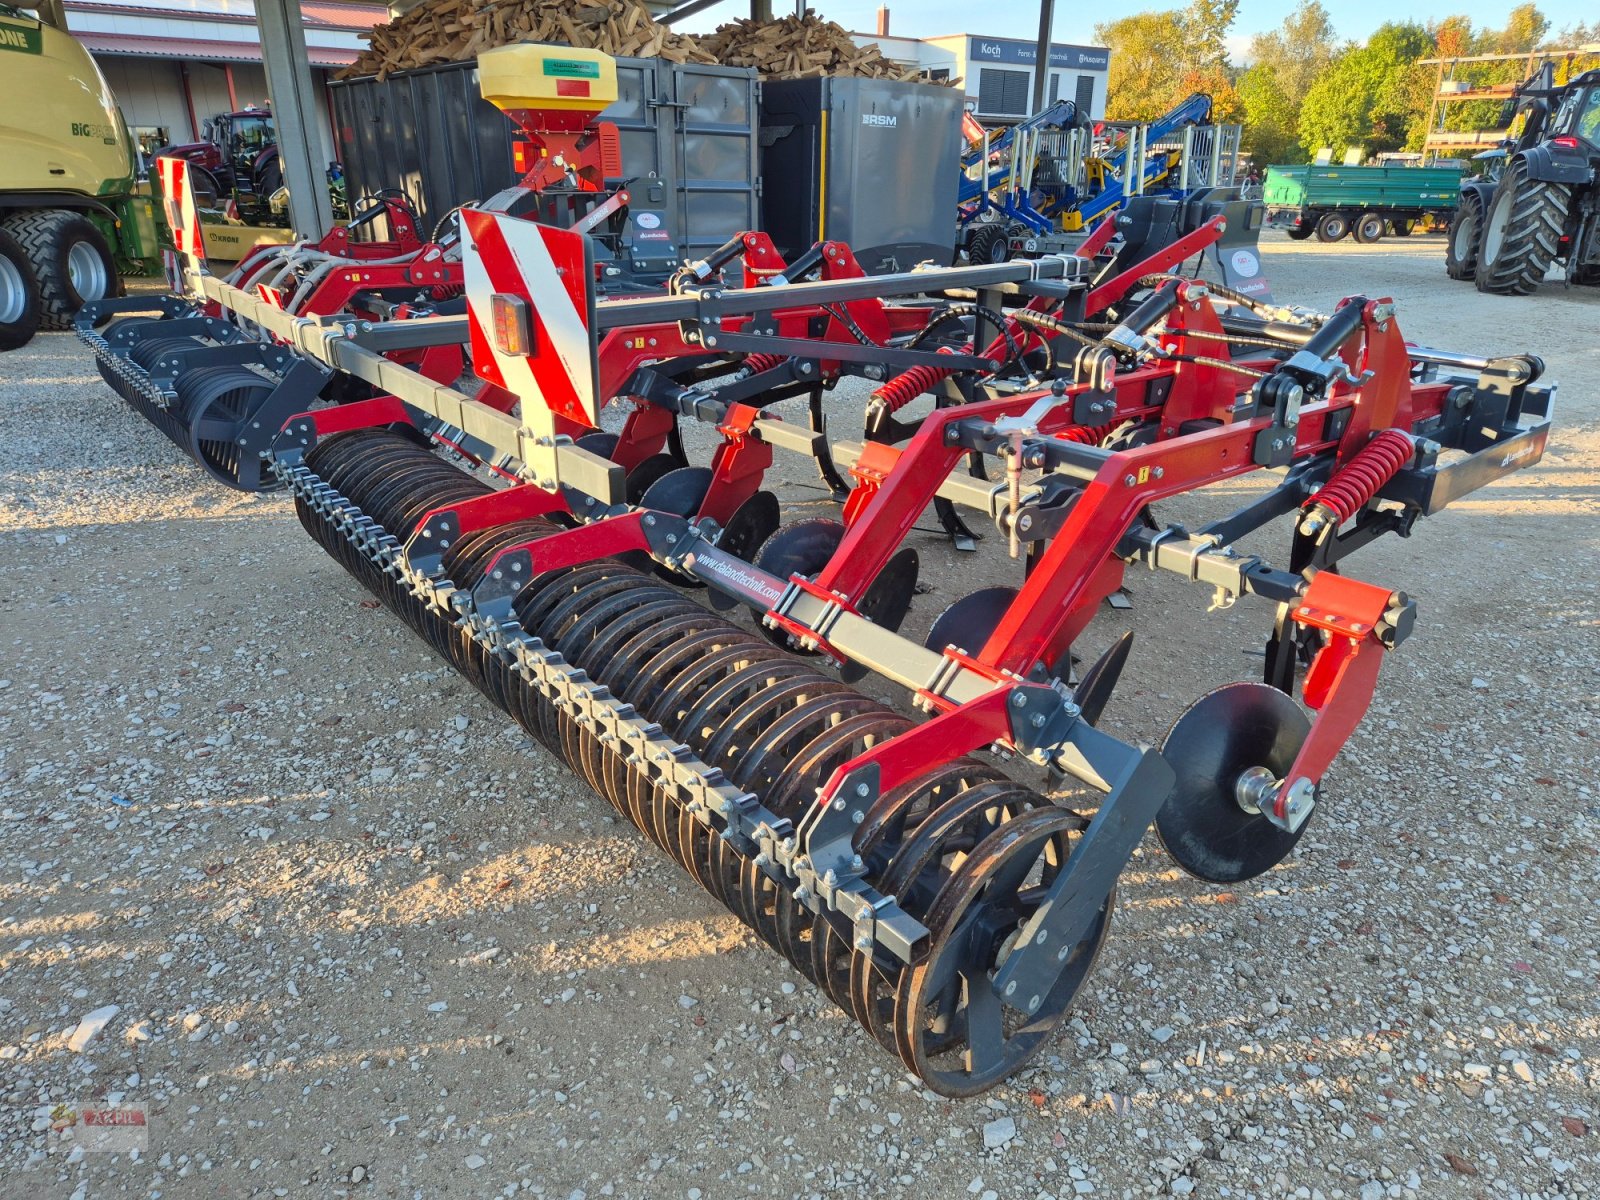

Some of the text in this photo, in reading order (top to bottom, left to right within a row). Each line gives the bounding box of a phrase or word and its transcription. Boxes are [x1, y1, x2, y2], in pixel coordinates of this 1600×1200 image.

[981, 43, 1001, 55] Koch
[869, 115, 897, 126] RSM
[217, 235, 239, 244] KRONE
[1027, 241, 1036, 251] 25
[696, 553, 782, 601] www.dalandtechnik.com
